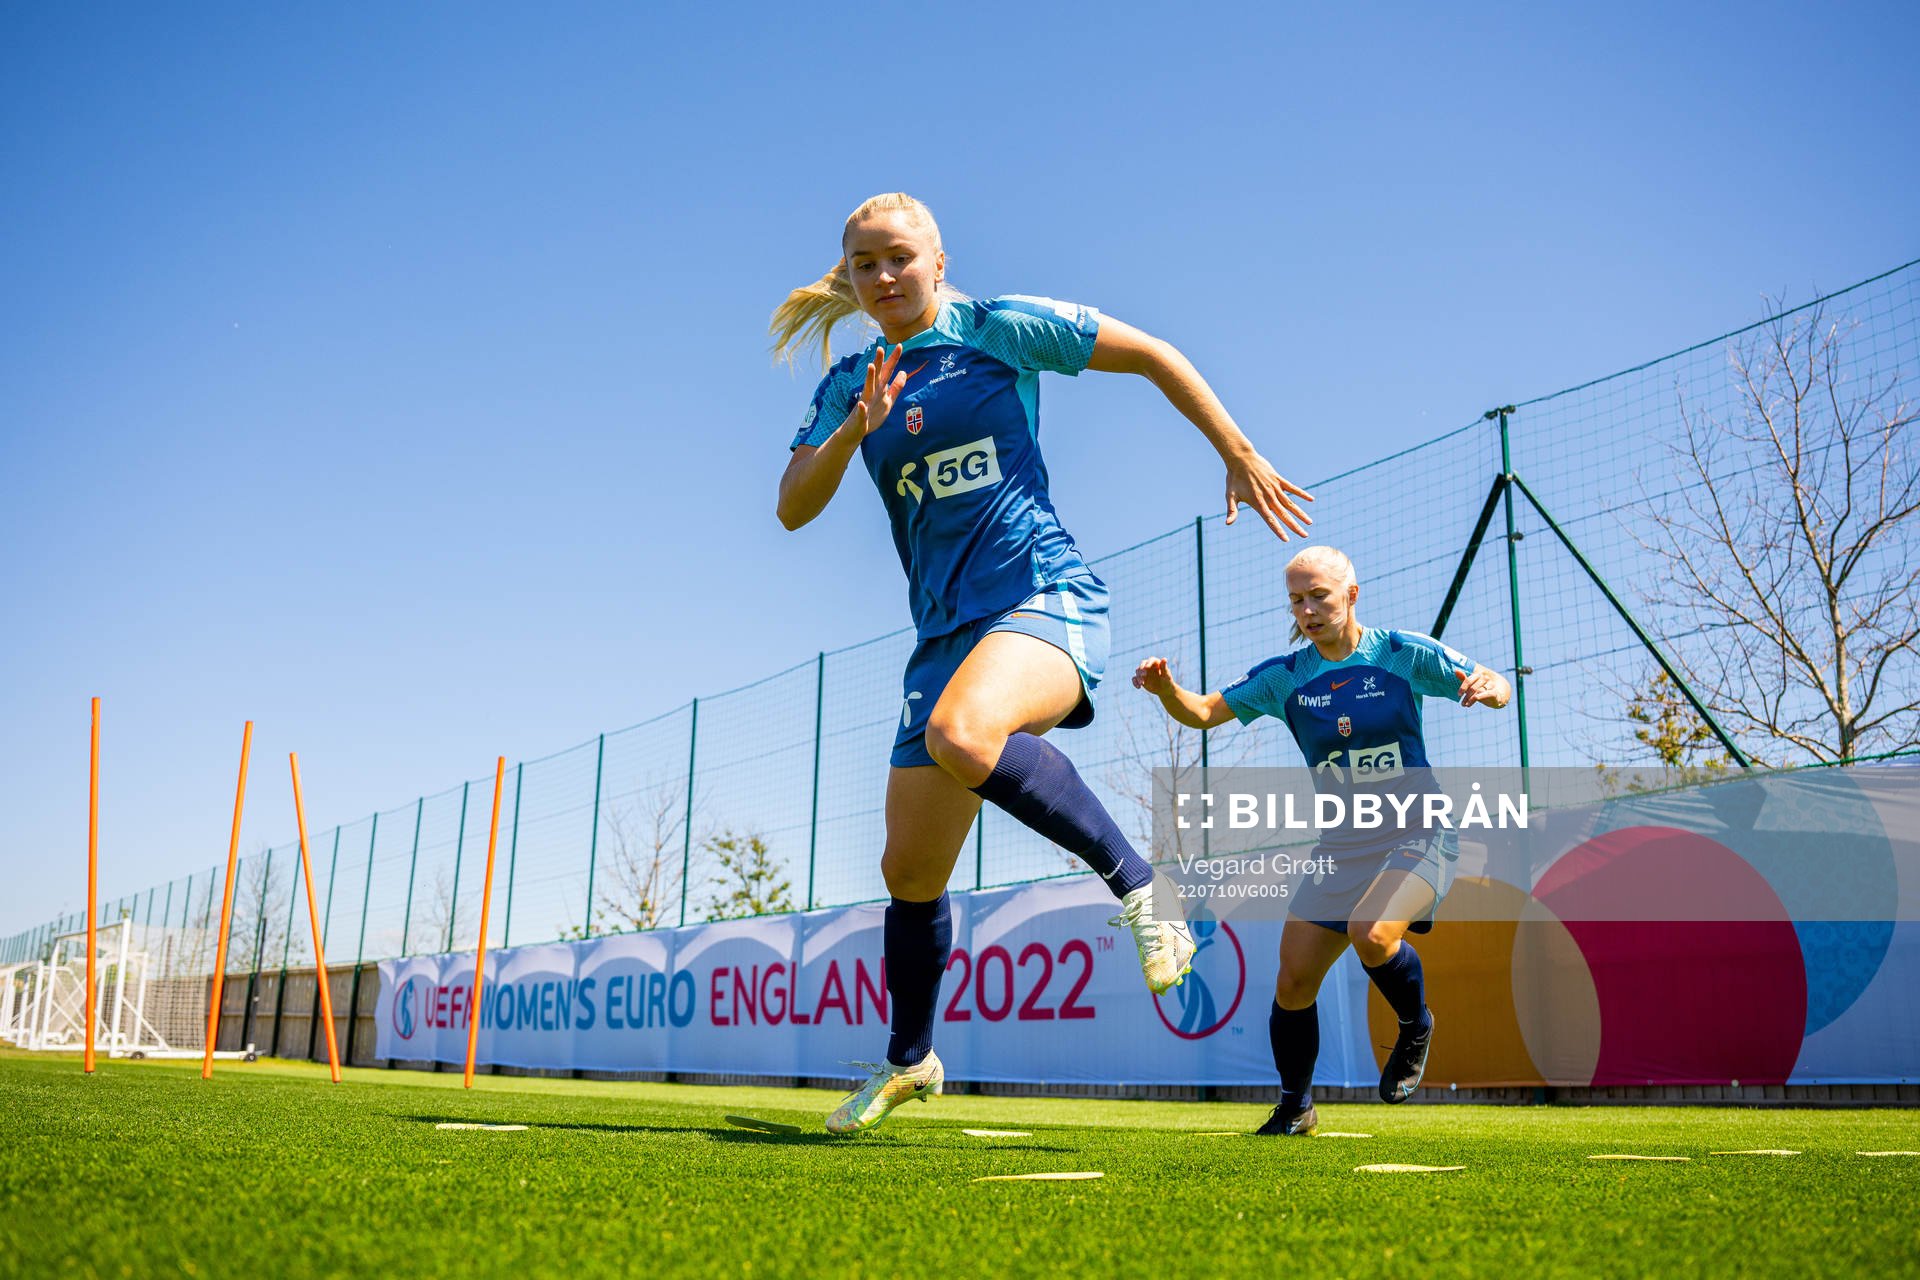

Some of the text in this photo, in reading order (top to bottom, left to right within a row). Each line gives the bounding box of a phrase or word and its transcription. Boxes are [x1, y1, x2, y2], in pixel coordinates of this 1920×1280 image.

[937, 450, 988, 487] 5G
[1297, 694, 1321, 707] KIWI
[1357, 751, 1396, 776] 5G
[605, 969, 697, 1030] EURO
[710, 955, 889, 1026] ENGLAN
[943, 939, 1096, 1022] 2022
